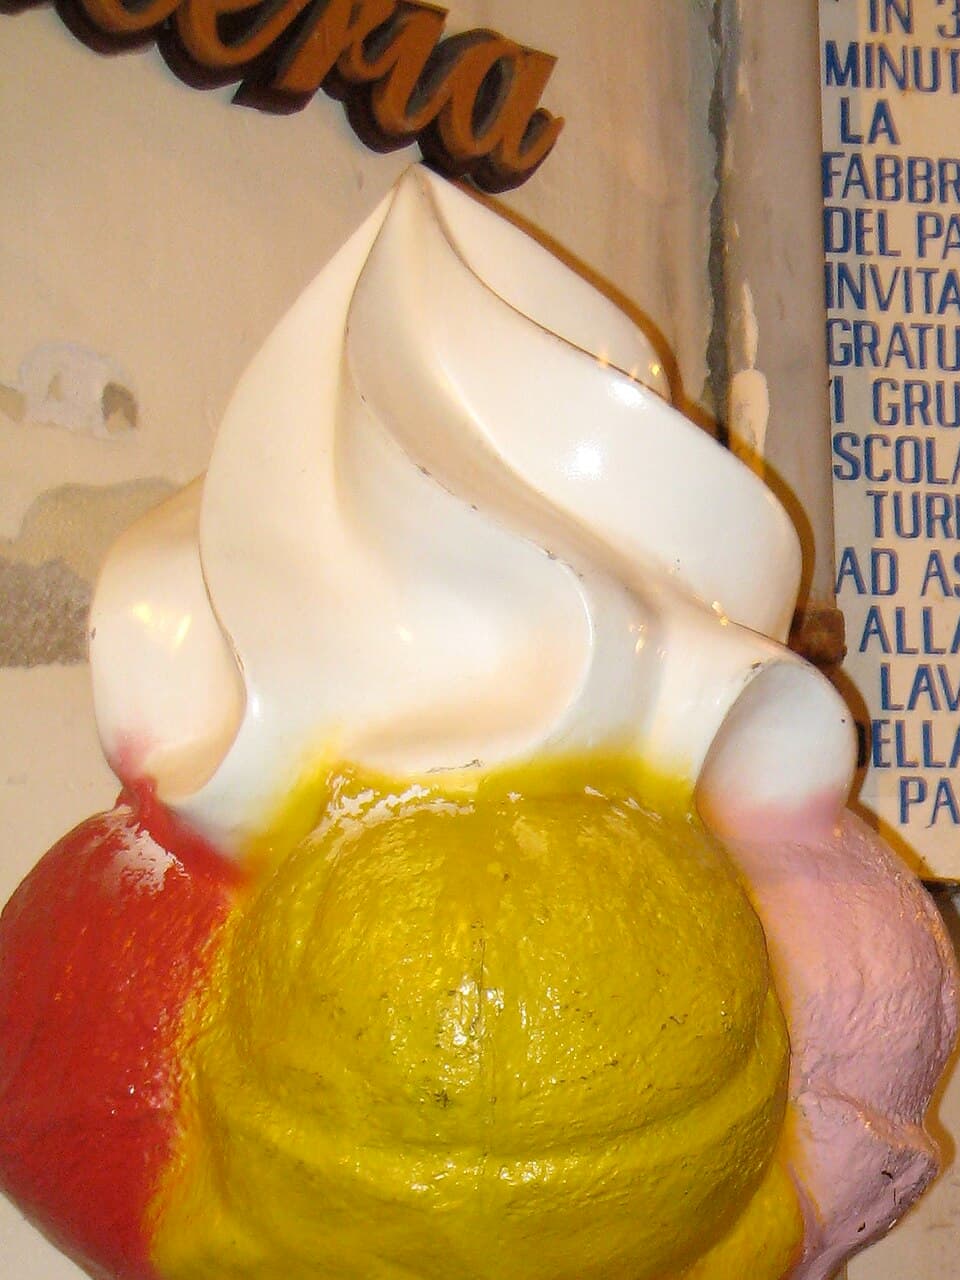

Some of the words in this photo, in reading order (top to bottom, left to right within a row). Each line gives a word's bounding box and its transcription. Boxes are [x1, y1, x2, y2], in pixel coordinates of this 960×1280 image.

[869, 0, 914, 34] IN
[840, 97, 900, 145] LA
[824, 206, 902, 257] DEL
[833, 375, 846, 424] I
[835, 546, 900, 597] AD
